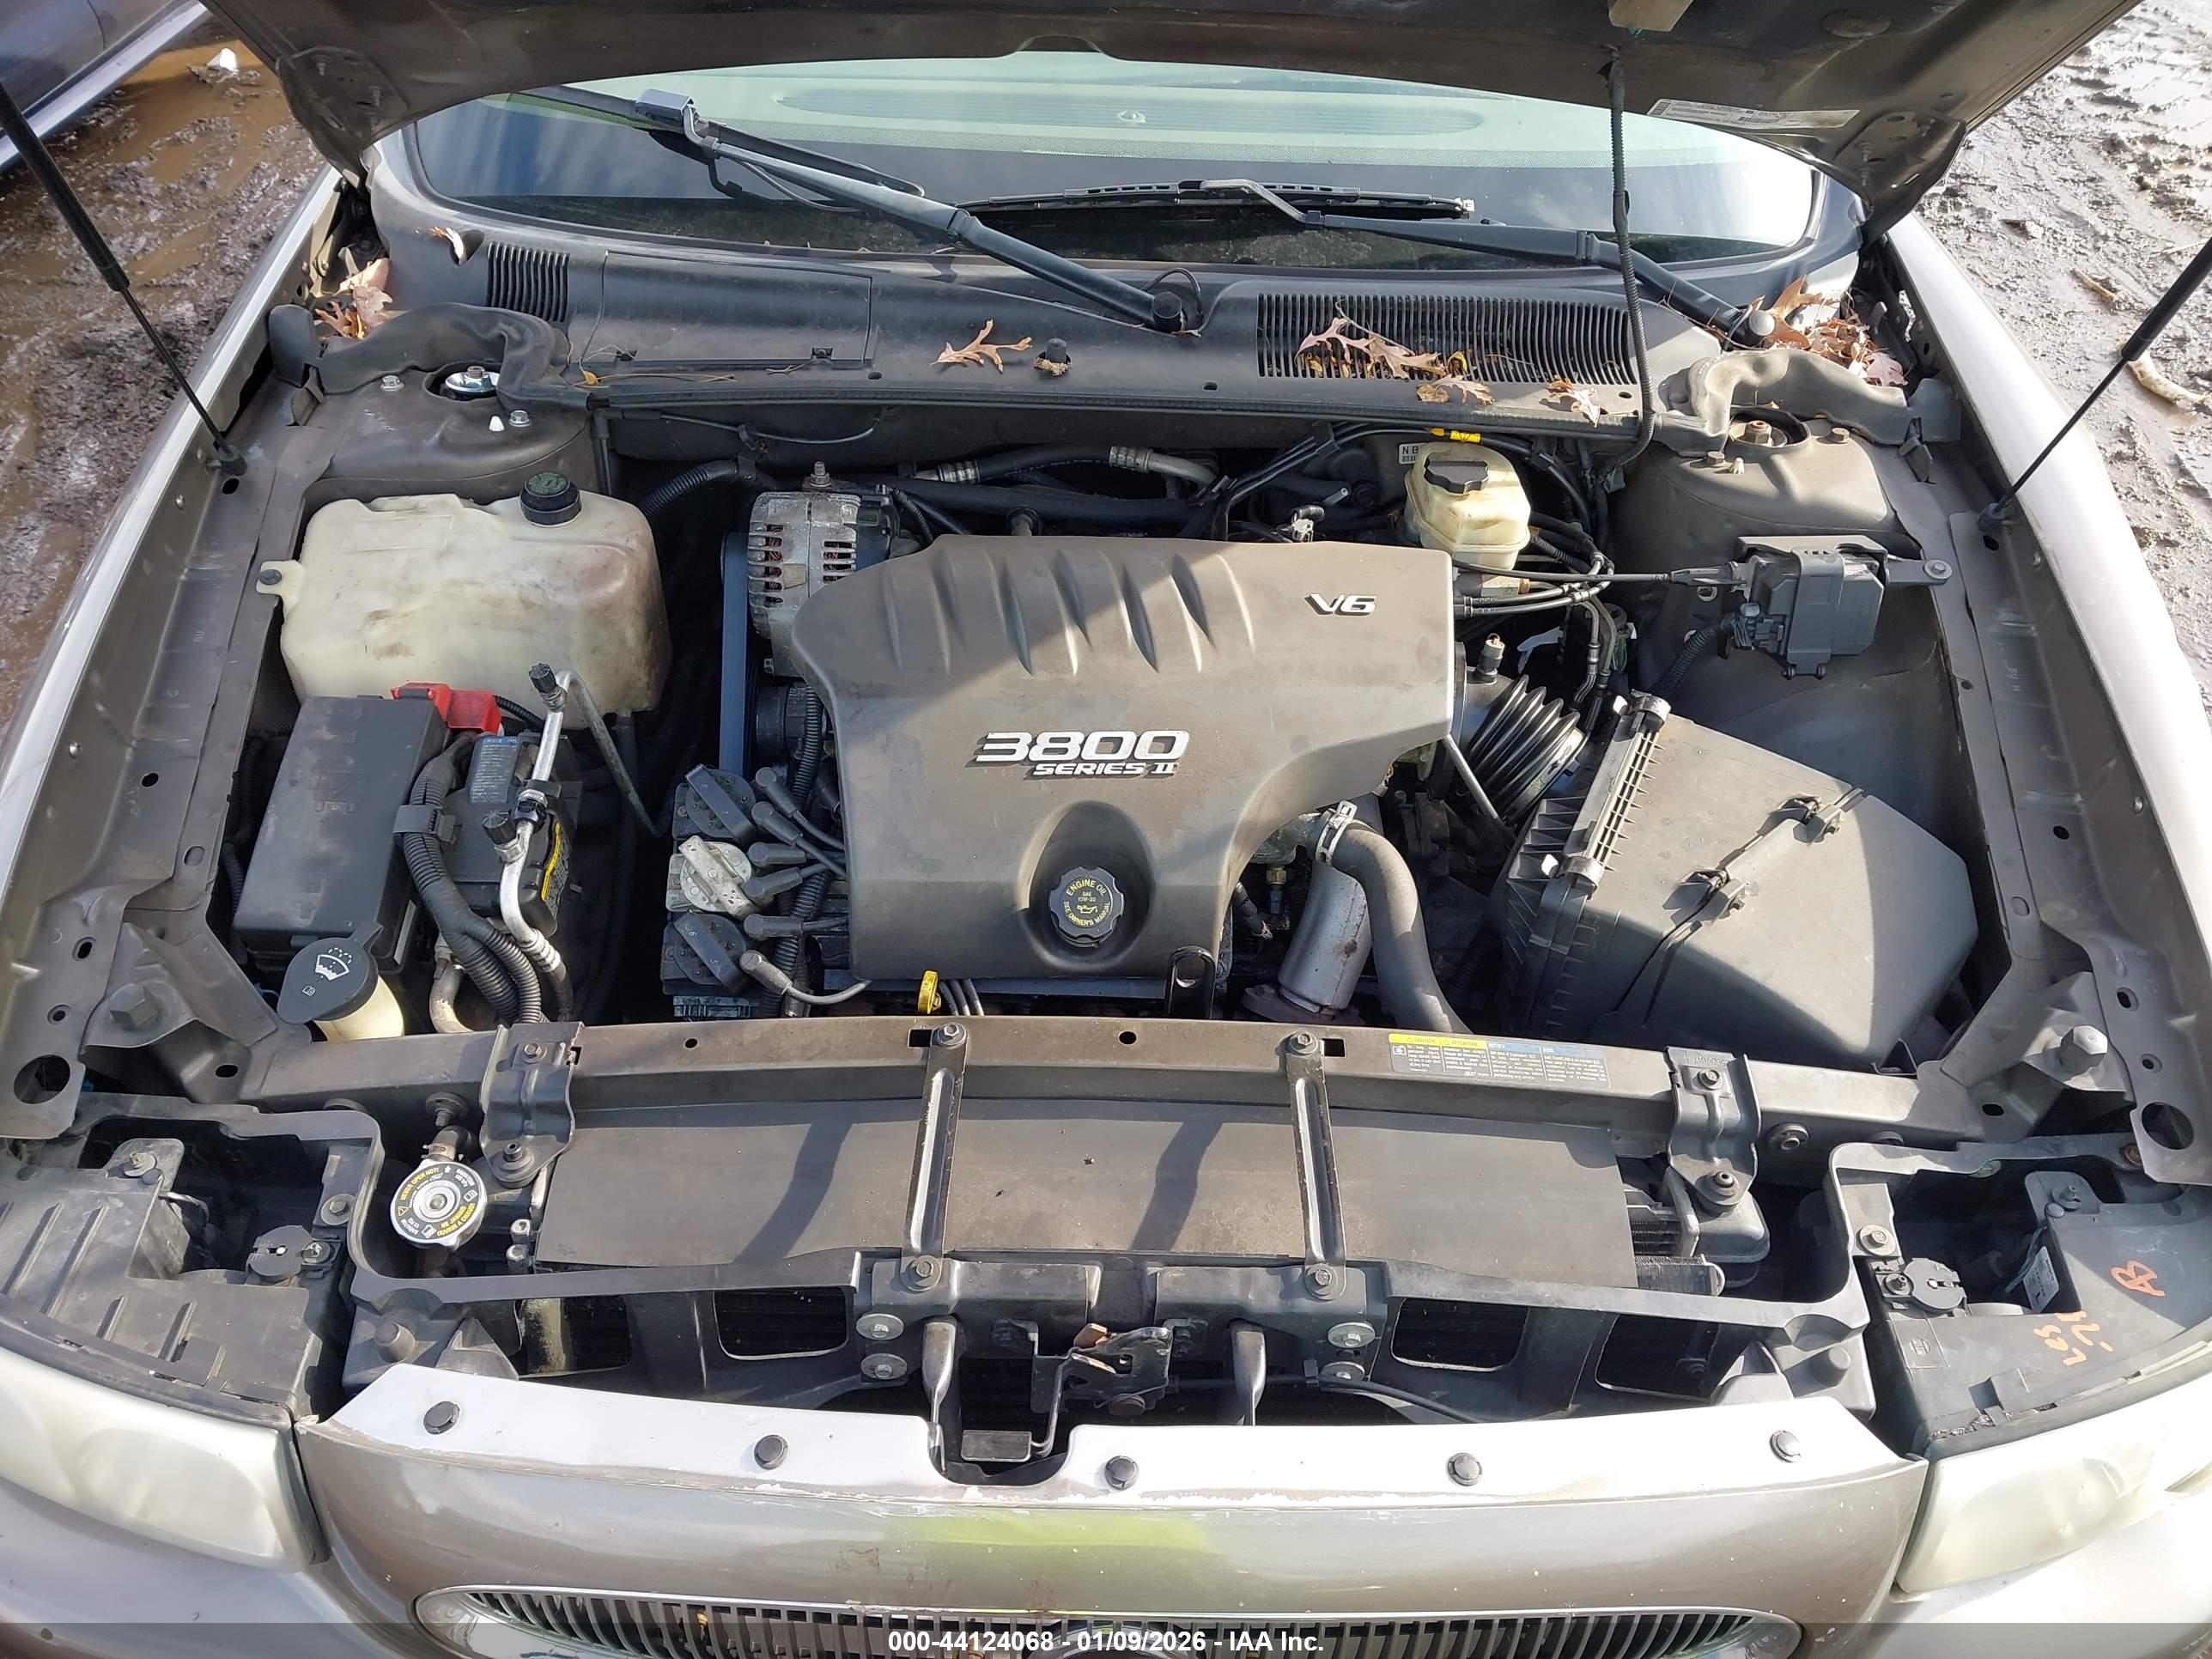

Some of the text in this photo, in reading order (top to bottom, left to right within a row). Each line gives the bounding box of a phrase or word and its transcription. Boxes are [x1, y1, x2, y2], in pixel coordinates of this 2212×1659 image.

[1306, 593, 1377, 615] V6
[975, 730, 1190, 763] 3800
[1033, 762, 1180, 775] SERIES II
[1066, 878, 1107, 897] ENGINE OIL
[1094, 901, 1111, 924] MANUAL
[411, 1173, 427, 1185] OPEN
